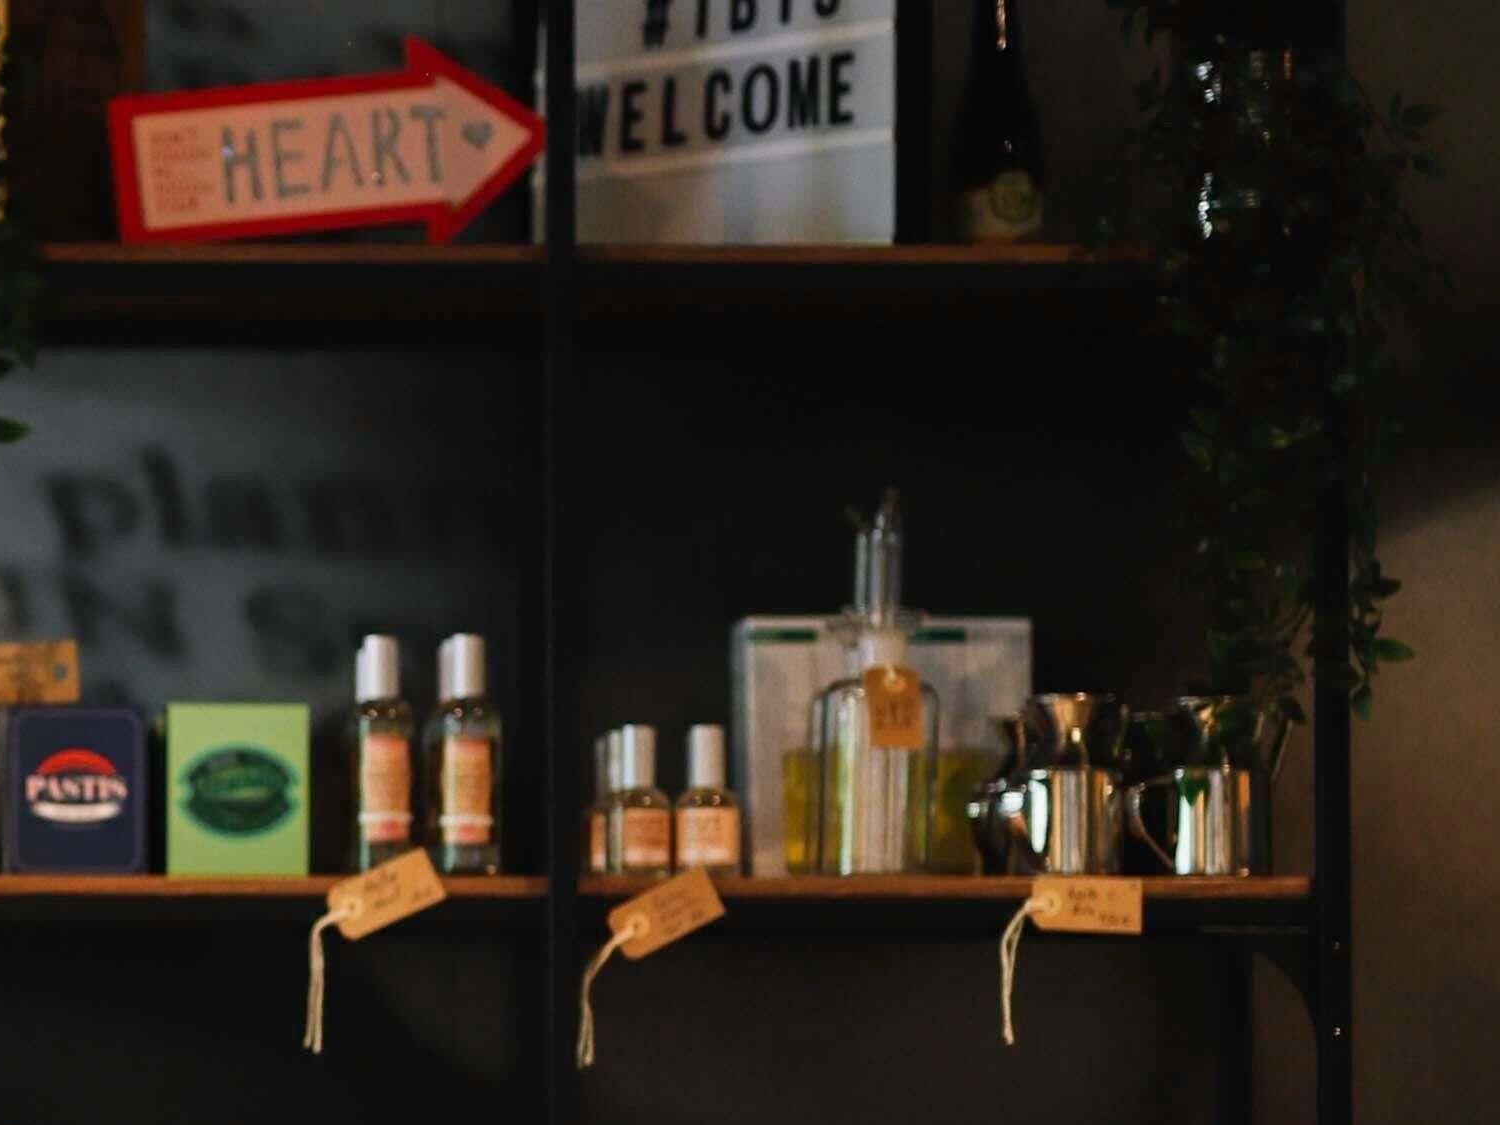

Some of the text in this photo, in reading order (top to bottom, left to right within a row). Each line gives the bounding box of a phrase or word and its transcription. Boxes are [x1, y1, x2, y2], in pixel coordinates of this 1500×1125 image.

[577, 50, 855, 157] WELCOME
[220, 104, 449, 204] HEART
[26, 774, 129, 801] PASTIS
